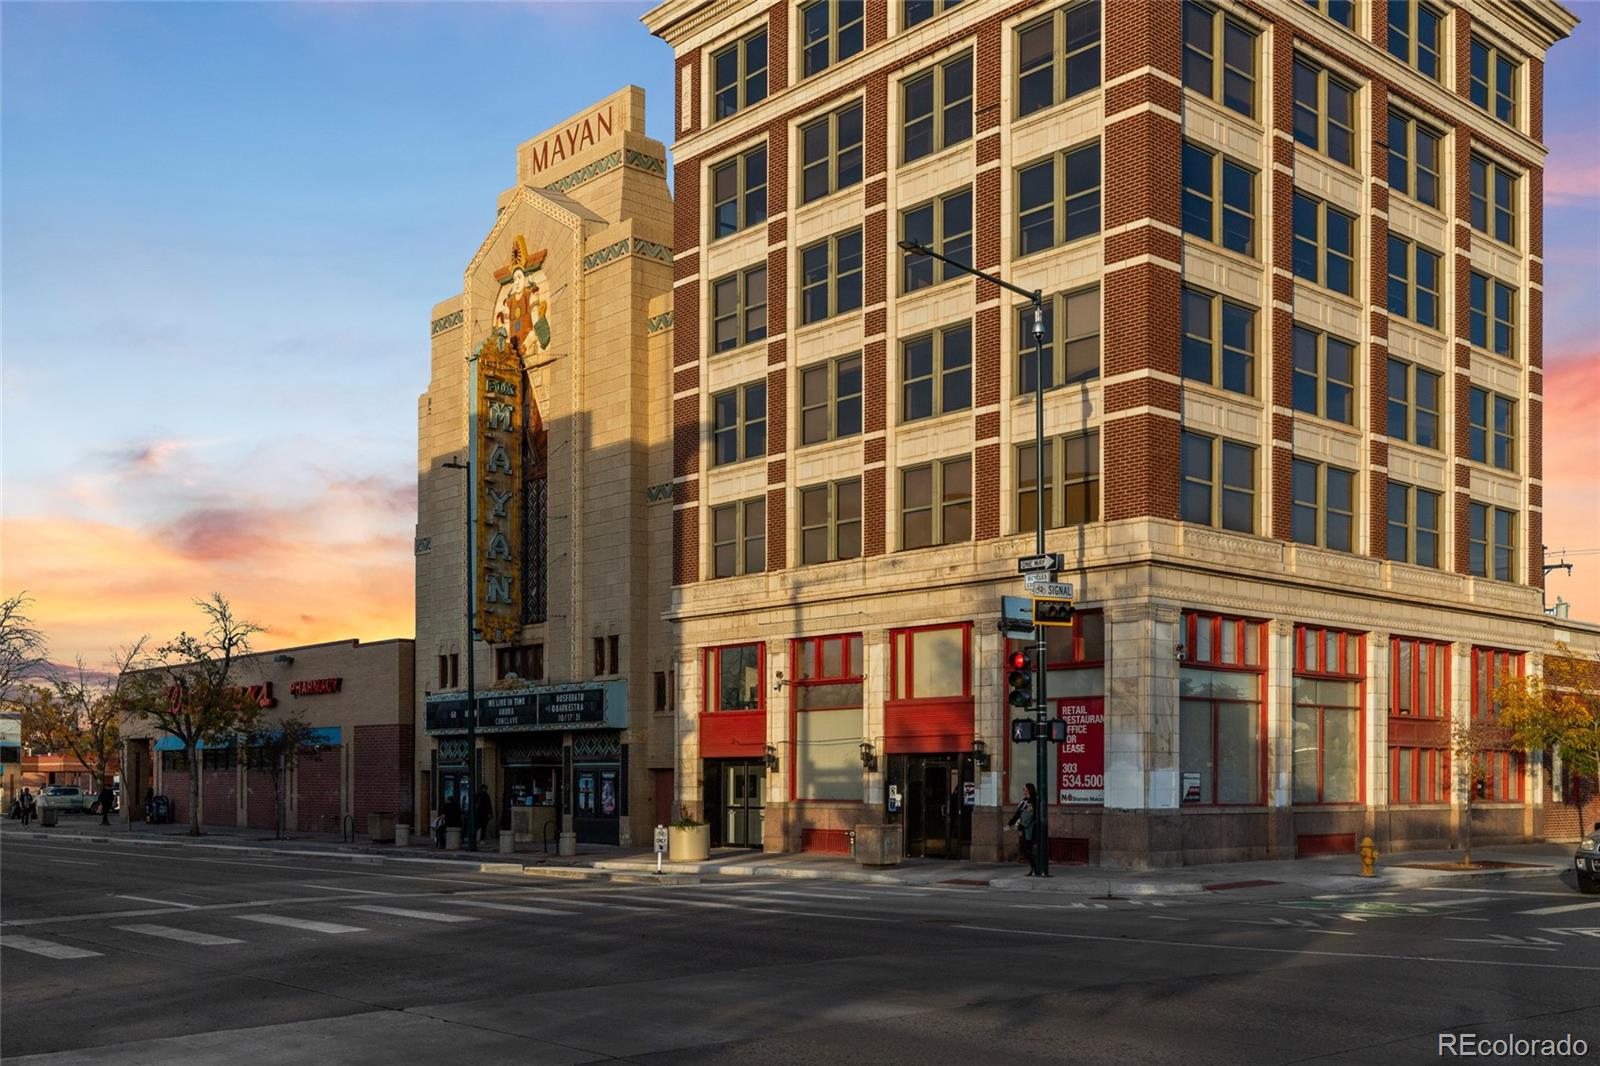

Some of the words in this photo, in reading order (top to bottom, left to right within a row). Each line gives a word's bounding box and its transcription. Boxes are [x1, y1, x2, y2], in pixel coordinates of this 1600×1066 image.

[532, 106, 612, 175] MAYAN
[486, 378, 514, 395] FOX
[486, 401, 514, 604] MAYAN
[1048, 585, 1072, 596] SIGNAL
[289, 678, 342, 695] PHARMACY
[514, 696, 525, 705] TIME
[1062, 705, 1087, 714] RETAIL
[495, 715, 518, 725] CONCLAVE
[1066, 725, 1087, 733] FFICE
[1062, 744, 1086, 753] LEASE
[1062, 763, 1077, 773] 303
